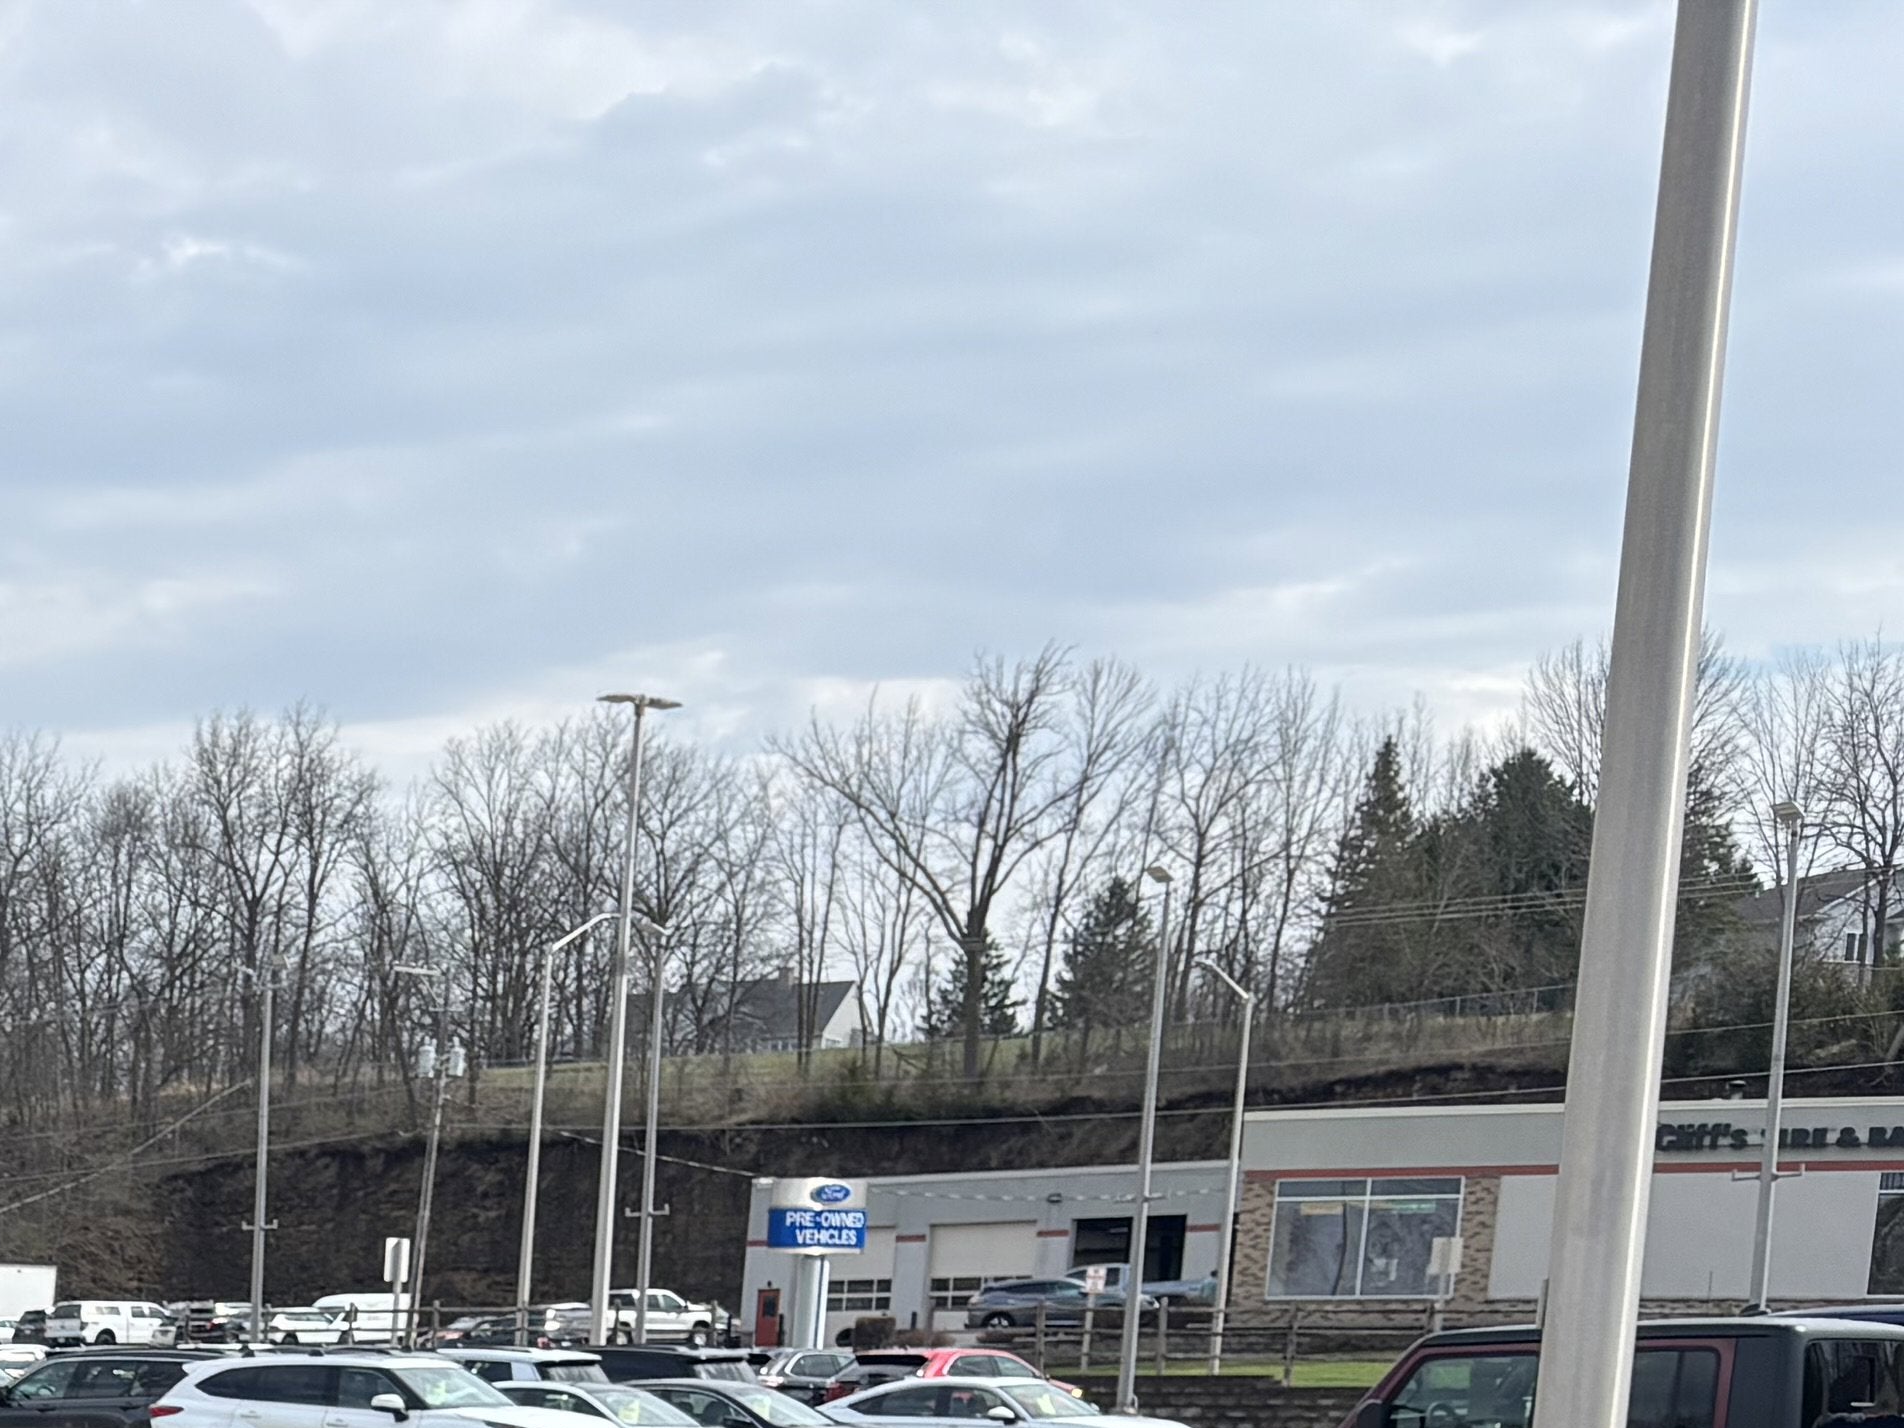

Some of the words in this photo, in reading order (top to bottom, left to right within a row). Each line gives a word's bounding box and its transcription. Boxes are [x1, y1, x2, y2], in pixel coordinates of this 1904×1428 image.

[1834, 1127, 1861, 1149] &
[785, 1211, 864, 1228] PRE-OWNED
[795, 1229, 857, 1245] VEHICLES
